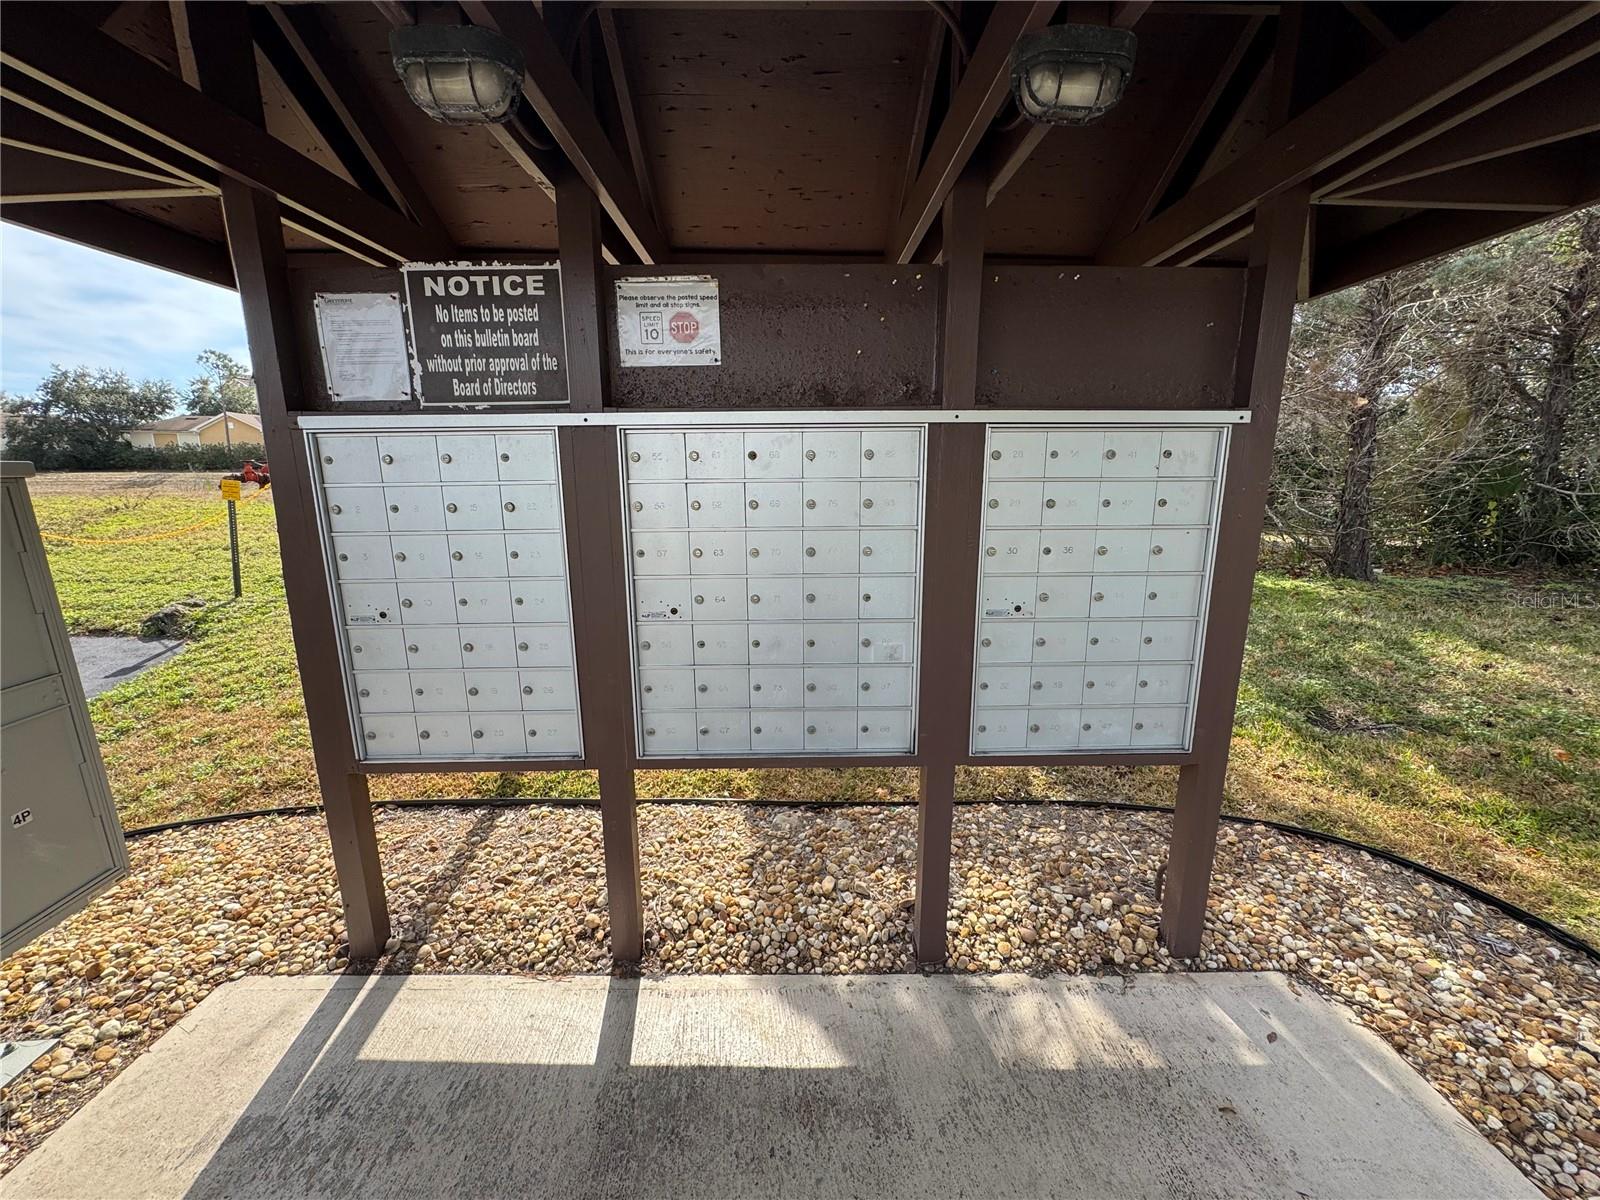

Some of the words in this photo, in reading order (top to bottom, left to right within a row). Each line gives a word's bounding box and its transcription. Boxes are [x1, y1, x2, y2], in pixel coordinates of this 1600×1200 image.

[423, 276, 545, 296] NOTICE
[435, 304, 449, 322] No
[451, 304, 478, 322] Items
[480, 305, 490, 322] to
[492, 304, 504, 322] be
[507, 303, 539, 326] posted
[645, 329, 659, 340] 10
[671, 322, 697, 334] STOP
[441, 334, 452, 347] on
[454, 329, 472, 347] this
[475, 329, 510, 347] bulletin
[512, 328, 539, 346] board
[427, 354, 462, 372] without
[465, 354, 486, 376] prior
[489, 354, 528, 376] approval
[531, 353, 541, 371] of
[542, 353, 558, 371] the
[452, 378, 480, 396] Board
[483, 378, 492, 395] of
[494, 378, 537, 395] Directors
[714, 549, 724, 557] 63
[1007, 547, 1018, 555] 30
[14, 810, 31, 824] 4P
